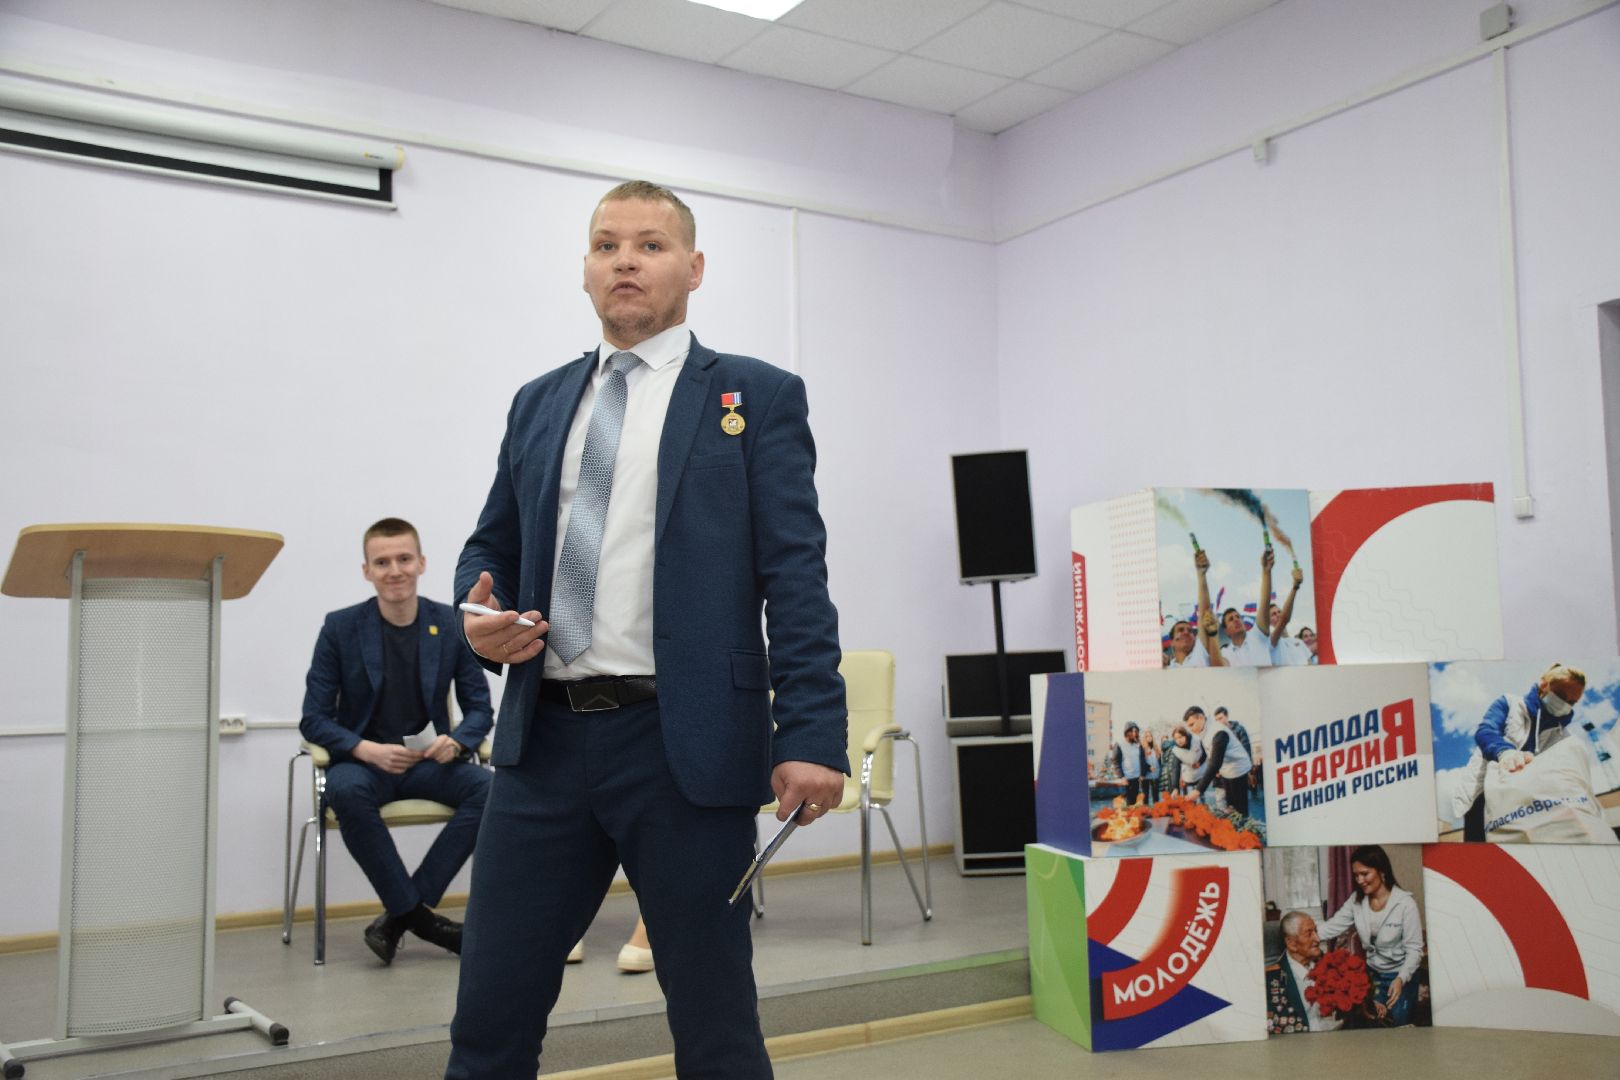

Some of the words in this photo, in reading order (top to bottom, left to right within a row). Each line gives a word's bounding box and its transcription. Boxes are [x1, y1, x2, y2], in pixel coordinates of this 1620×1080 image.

[1278, 779, 1346, 816] ЕДИНОЙ
[1352, 760, 1418, 794] РОССИИ
[1112, 882, 1221, 1005] МОЛОДЁЖЬ
